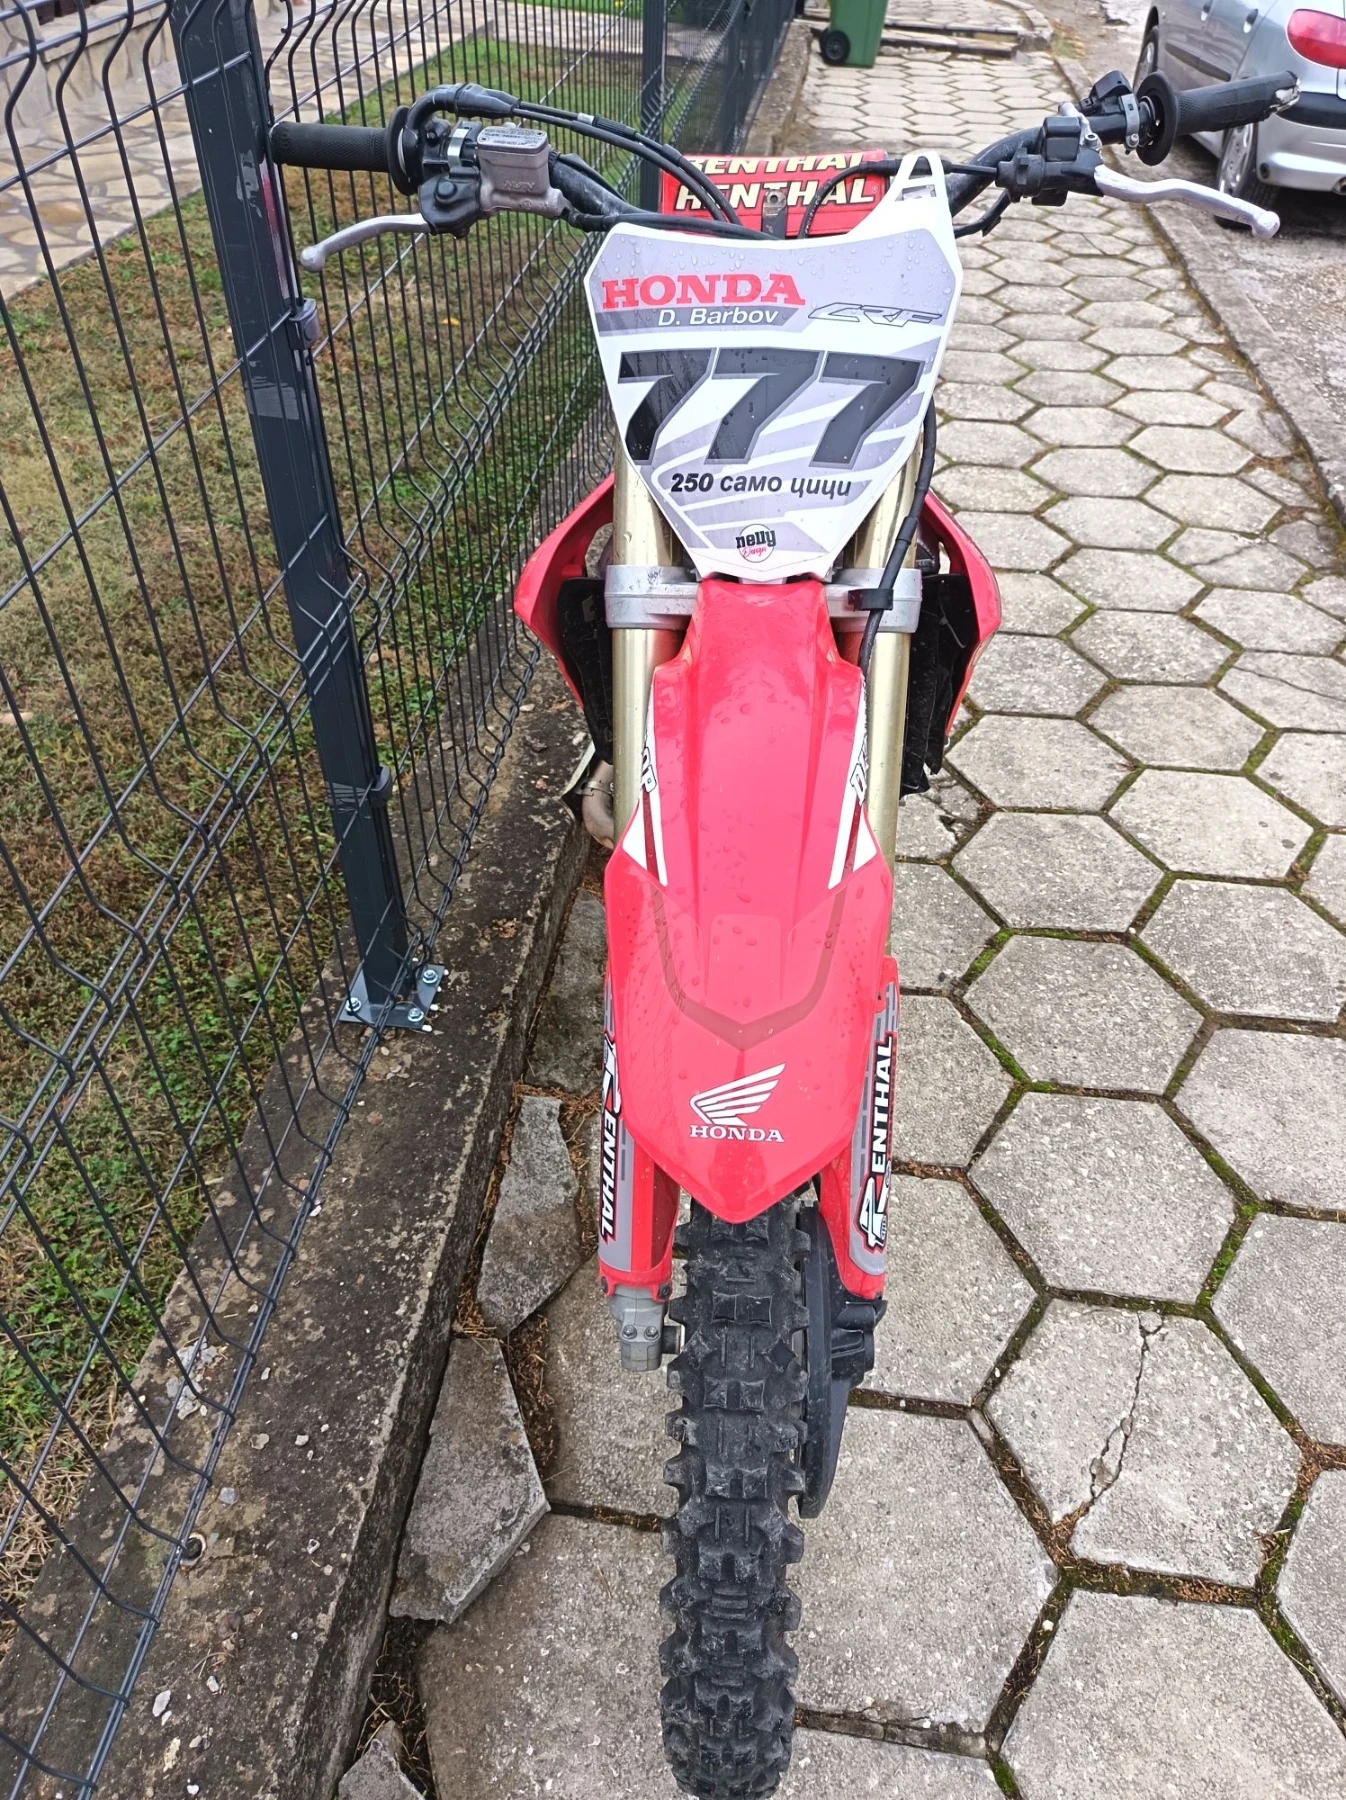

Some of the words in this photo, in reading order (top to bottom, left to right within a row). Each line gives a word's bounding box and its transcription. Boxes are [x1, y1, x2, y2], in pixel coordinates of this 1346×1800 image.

[602, 273, 805, 310] HONDA
[658, 308, 679, 326] D.
[690, 306, 779, 326] Barbov
[808, 301, 942, 327] CRF
[618, 347, 925, 469] 777
[671, 472, 713, 493] 250
[720, 474, 782, 493] само
[790, 475, 851, 499] цици
[735, 530, 777, 549] nelly
[689, 1124, 784, 1143] HONDA
[859, 1036, 892, 1247] RENTHAL
